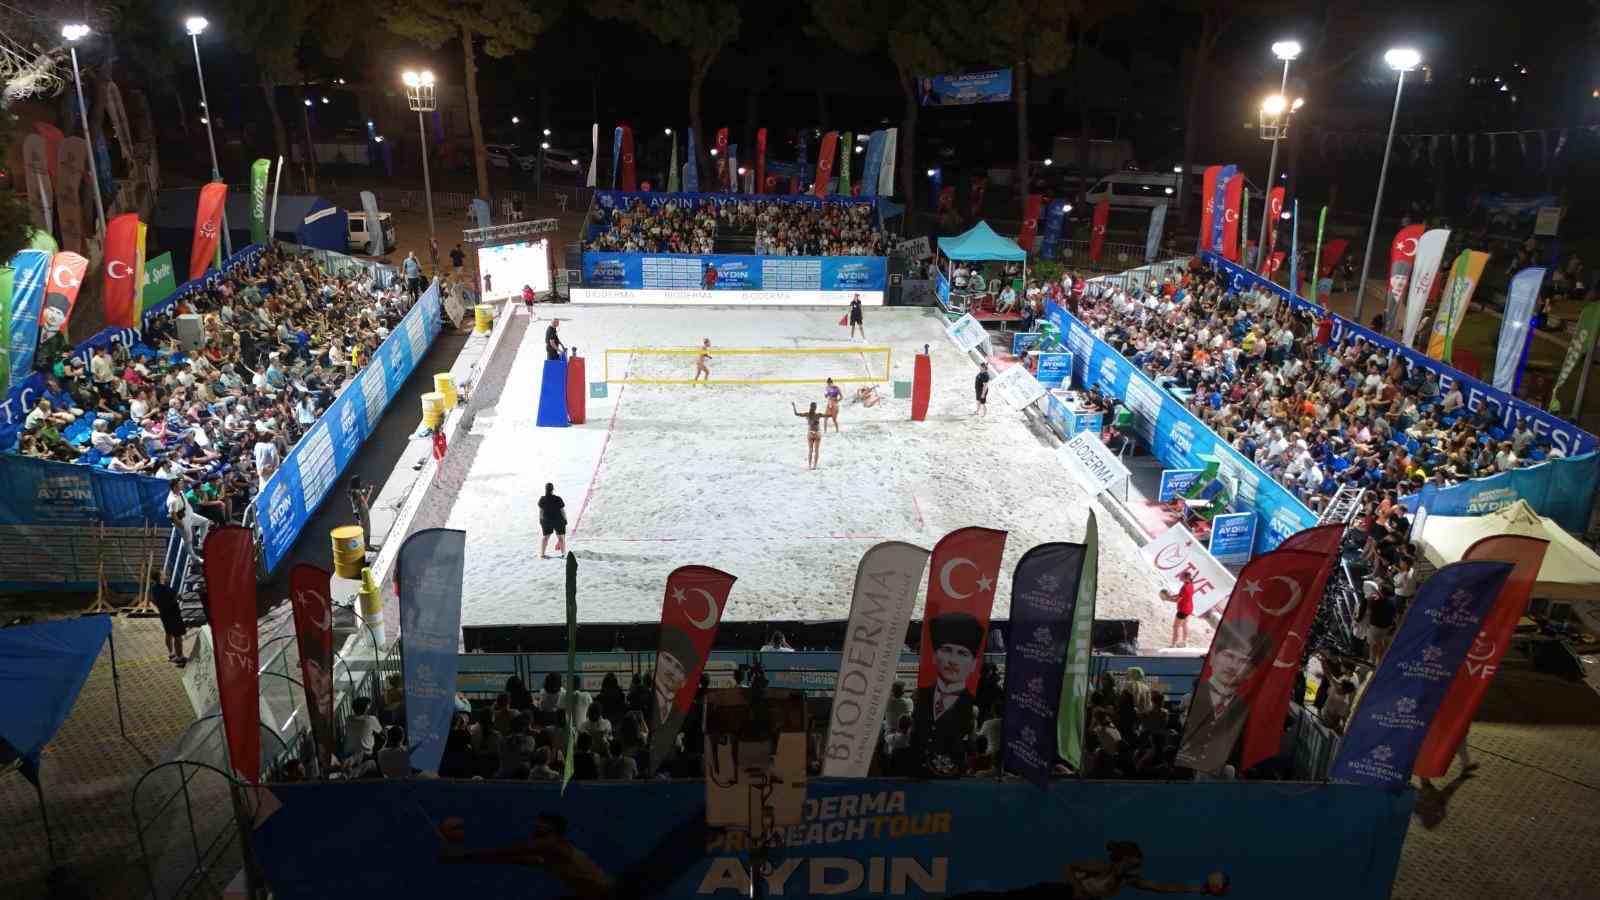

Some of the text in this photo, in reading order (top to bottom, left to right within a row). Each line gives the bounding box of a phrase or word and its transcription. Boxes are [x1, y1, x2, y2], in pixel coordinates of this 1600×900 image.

[837, 272, 868, 280] AYDIN
[1069, 436, 1116, 485] BIODERMA
[37, 489, 93, 499] AYDIN
[1218, 525, 1249, 535] AYDIN
[827, 568, 897, 761] BIODERMA
[1465, 661, 1497, 679] VF
[696, 856, 949, 896] AYDIN
